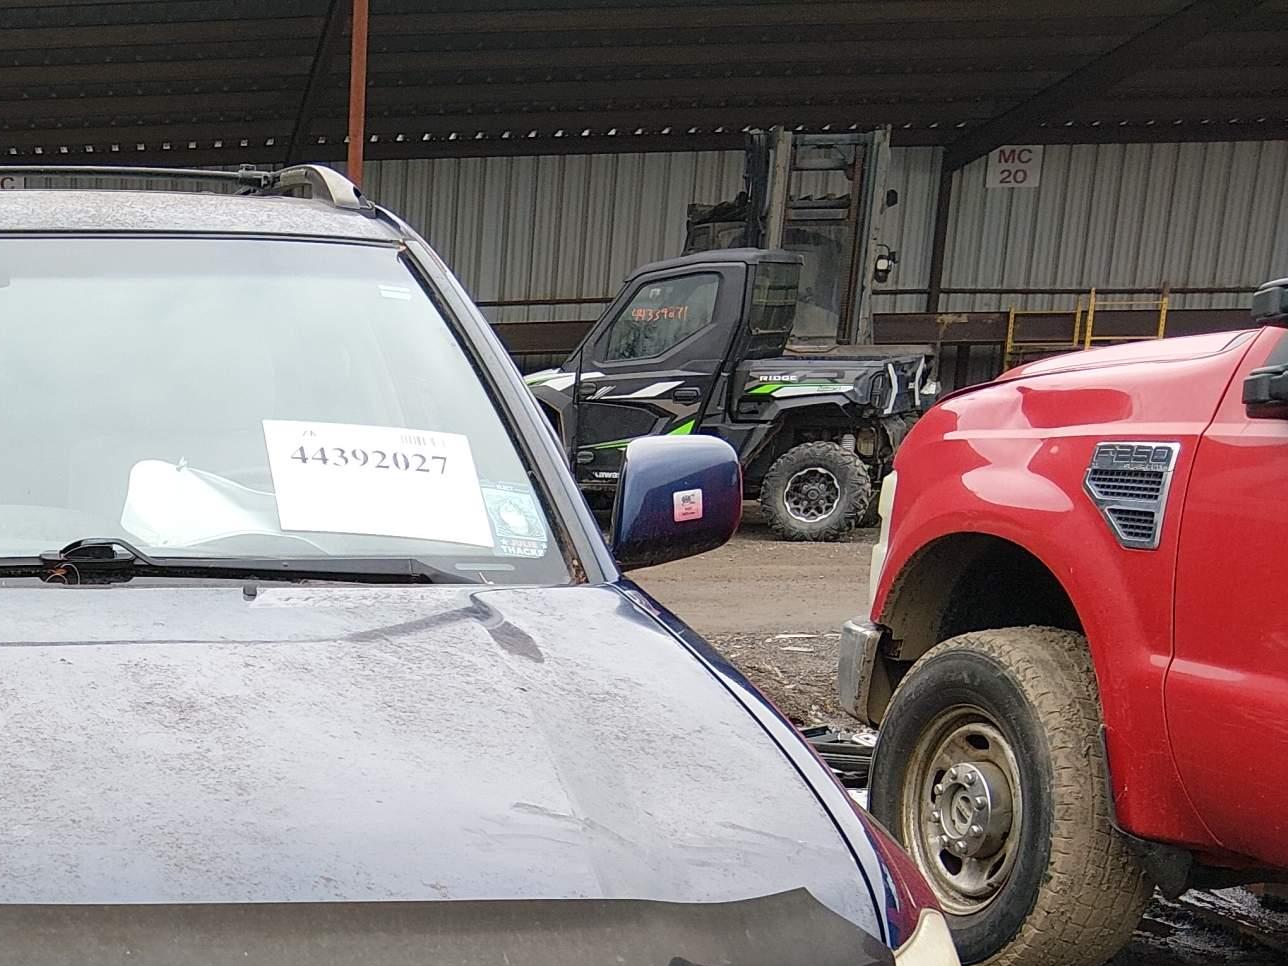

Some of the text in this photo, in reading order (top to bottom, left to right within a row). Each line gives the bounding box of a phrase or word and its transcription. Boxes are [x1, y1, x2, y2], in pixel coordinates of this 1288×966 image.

[998, 149, 1033, 164] MC
[999, 169, 1028, 184] 20
[290, 446, 447, 474] 44392027
